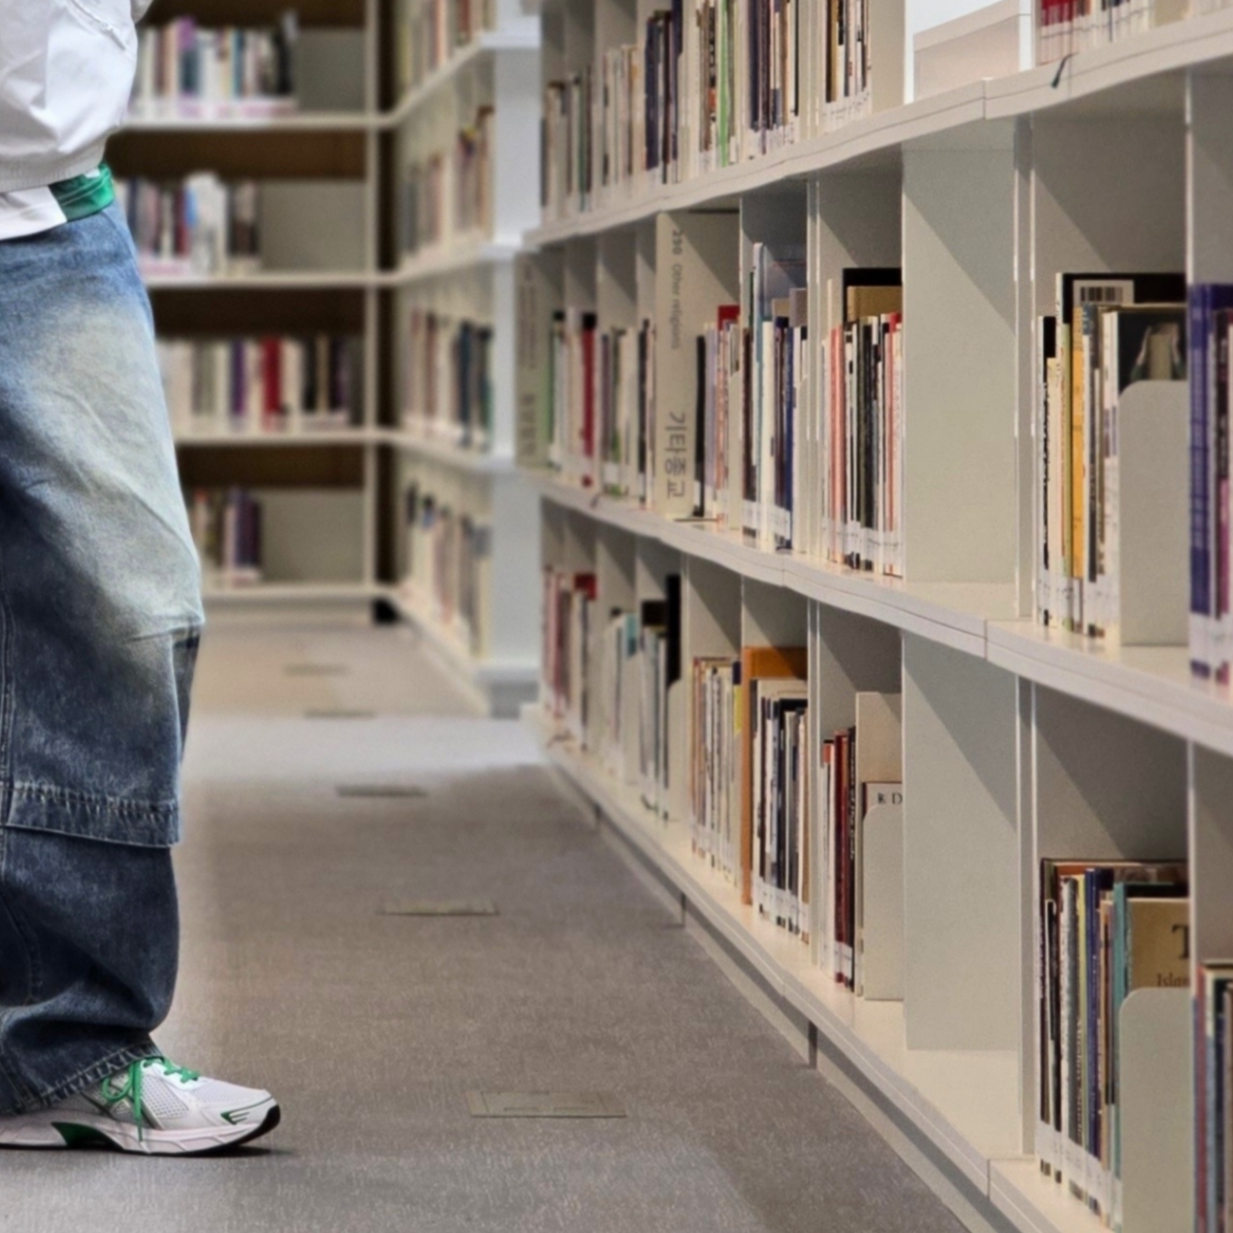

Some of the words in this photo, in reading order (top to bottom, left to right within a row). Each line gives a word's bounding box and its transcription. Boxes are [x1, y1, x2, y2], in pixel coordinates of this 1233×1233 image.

[672, 263, 683, 296] Other
[669, 299, 683, 350] religions
[664, 411, 688, 499] 기타종교
